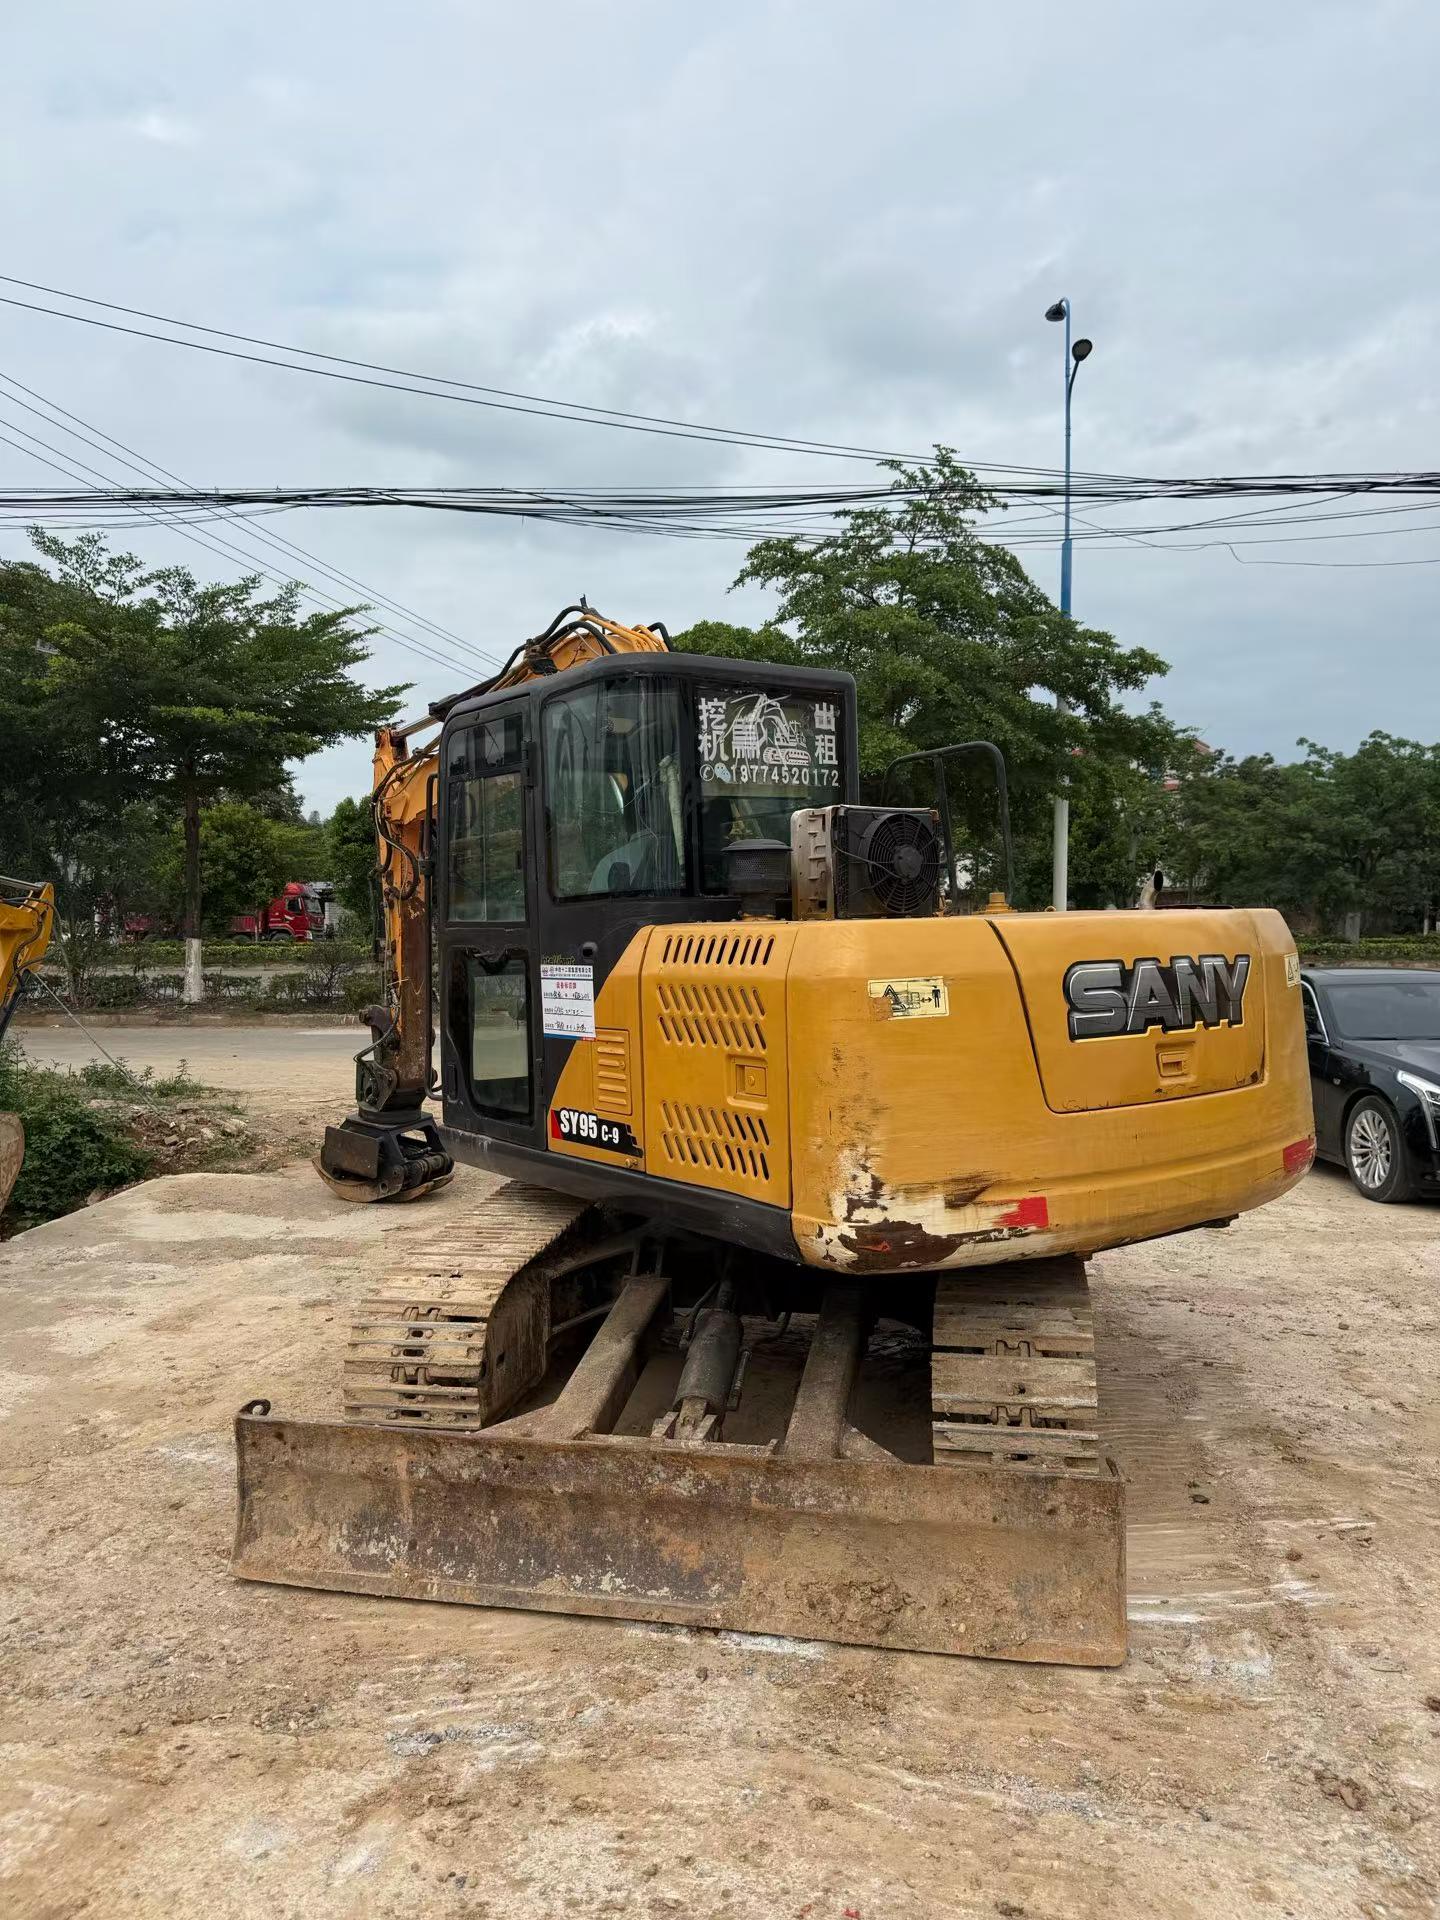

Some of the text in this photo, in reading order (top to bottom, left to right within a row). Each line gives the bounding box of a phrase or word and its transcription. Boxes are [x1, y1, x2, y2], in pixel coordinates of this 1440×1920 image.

[698, 698, 729, 761] 挖机
[814, 702, 838, 764] 出租
[1065, 956, 1249, 1037] SANY
[560, 1109, 619, 1144] SY95 C-9
